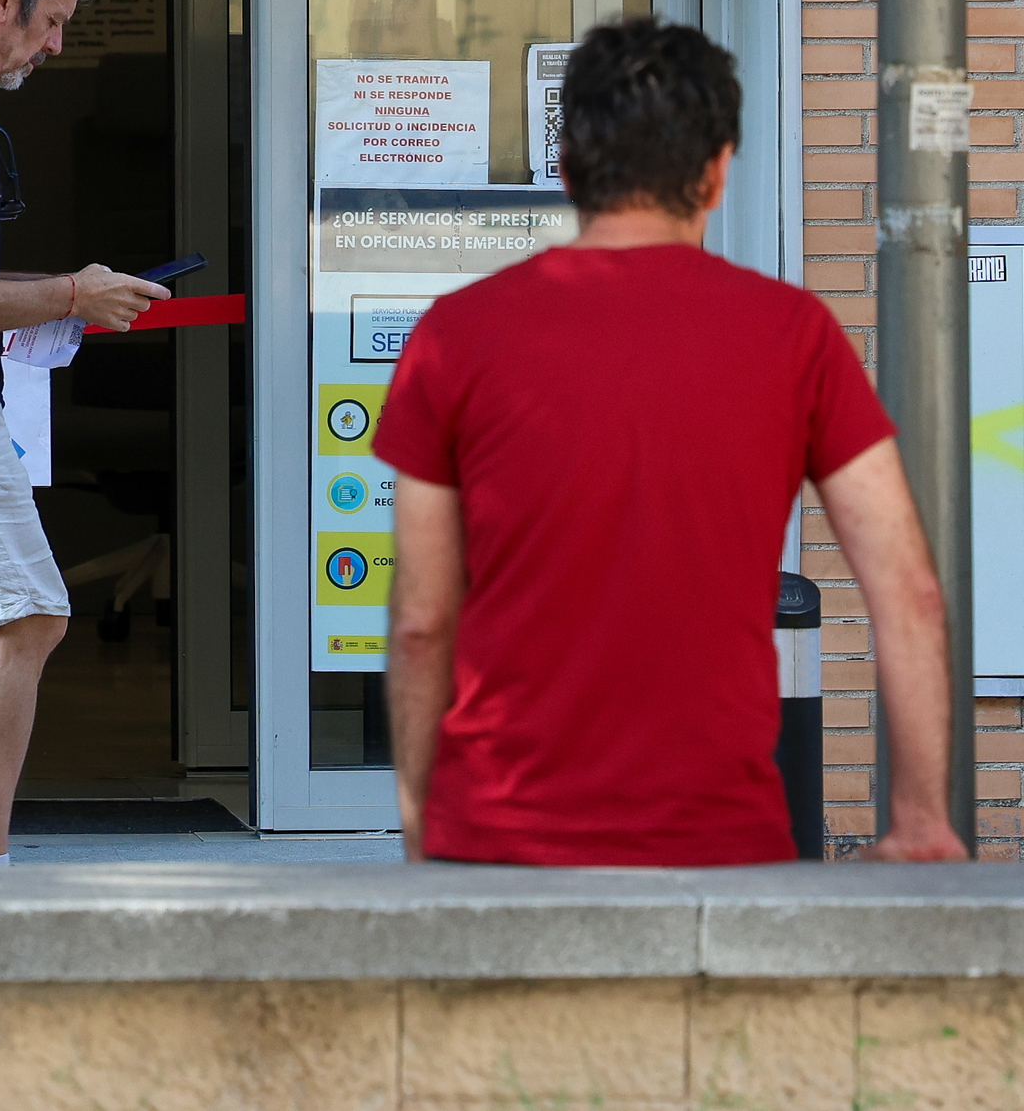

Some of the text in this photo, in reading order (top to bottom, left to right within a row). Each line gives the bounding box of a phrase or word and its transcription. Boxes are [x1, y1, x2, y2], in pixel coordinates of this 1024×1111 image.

[357, 75, 449, 84] NO SE TRAMITA
[354, 91, 452, 100] NI SE RESPONDE
[375, 106, 430, 115] NINGUNA
[328, 122, 476, 132] SOLICITUD O INCIDENCIA
[363, 138, 440, 147] POR CORREO
[360, 152, 443, 163] ELECTRÓNICO
[332, 208, 562, 228] ¿QUÉ SERVICIOS SE PRESTAN
[335, 235, 536, 250] EN OFICINAS DE EMPLEO?
[374, 498, 395, 506] REG
[373, 557, 396, 566] COB
